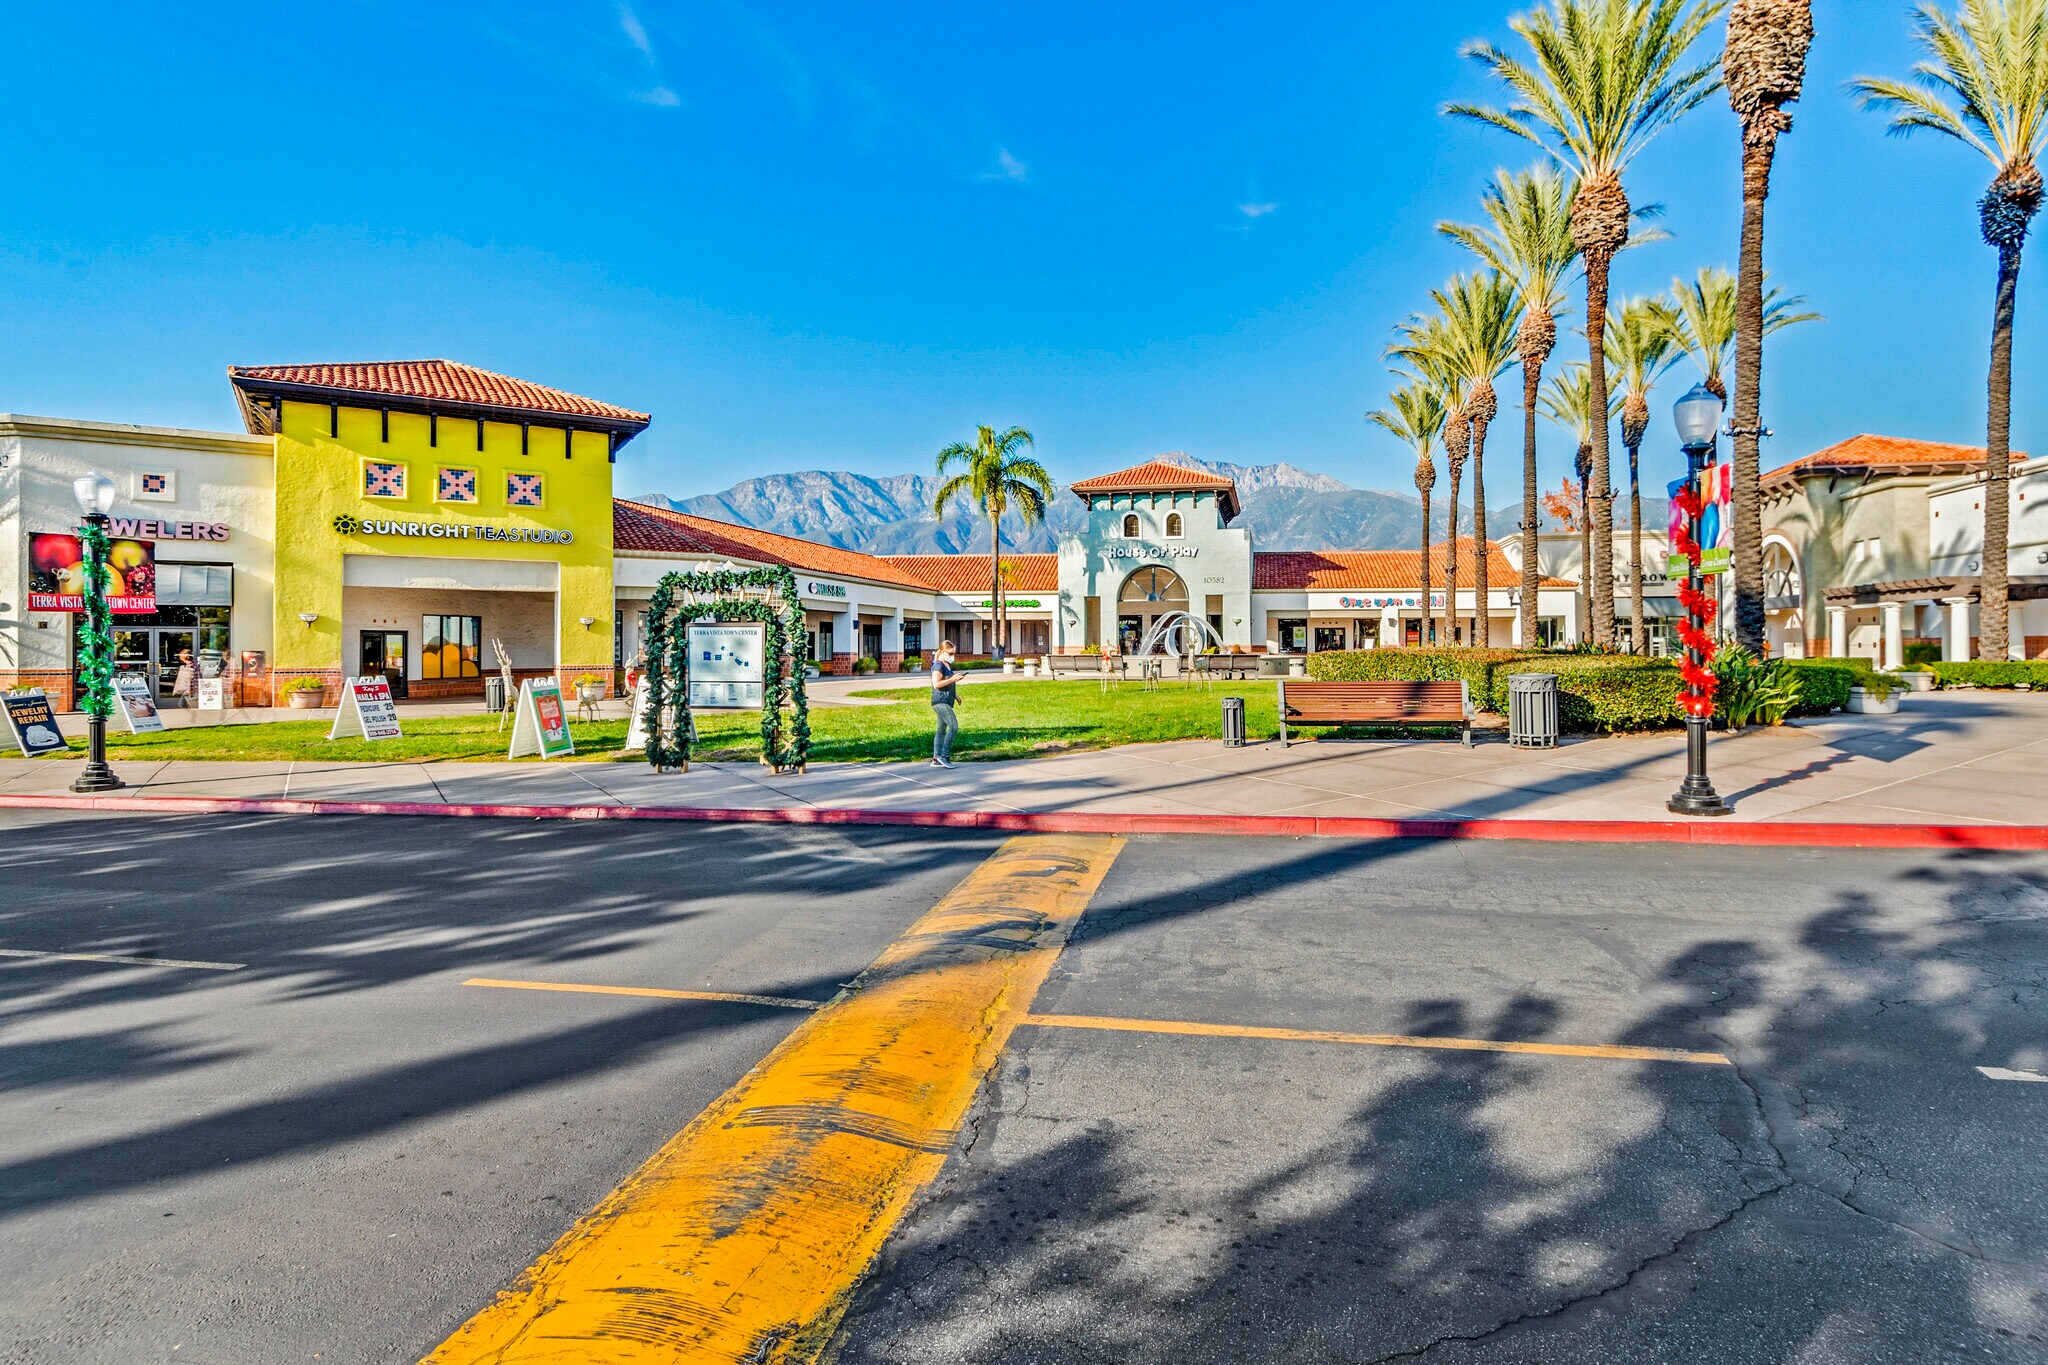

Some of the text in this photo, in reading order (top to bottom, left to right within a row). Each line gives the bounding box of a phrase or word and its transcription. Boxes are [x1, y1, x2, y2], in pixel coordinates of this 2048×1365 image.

[361, 520, 471, 539] SUNRIGHT
[1108, 546, 1148, 559] House
[1170, 546, 1199, 558] Play
[31, 595, 156, 609] TERRA VISTA TOWN CENTER
[1339, 595, 1444, 608] Once upon a cld
[356, 693, 374, 702] NAILS
[378, 692, 391, 701] SPA
[11, 706, 48, 717] JEWELRY
[17, 714, 49, 724] REPAIR
